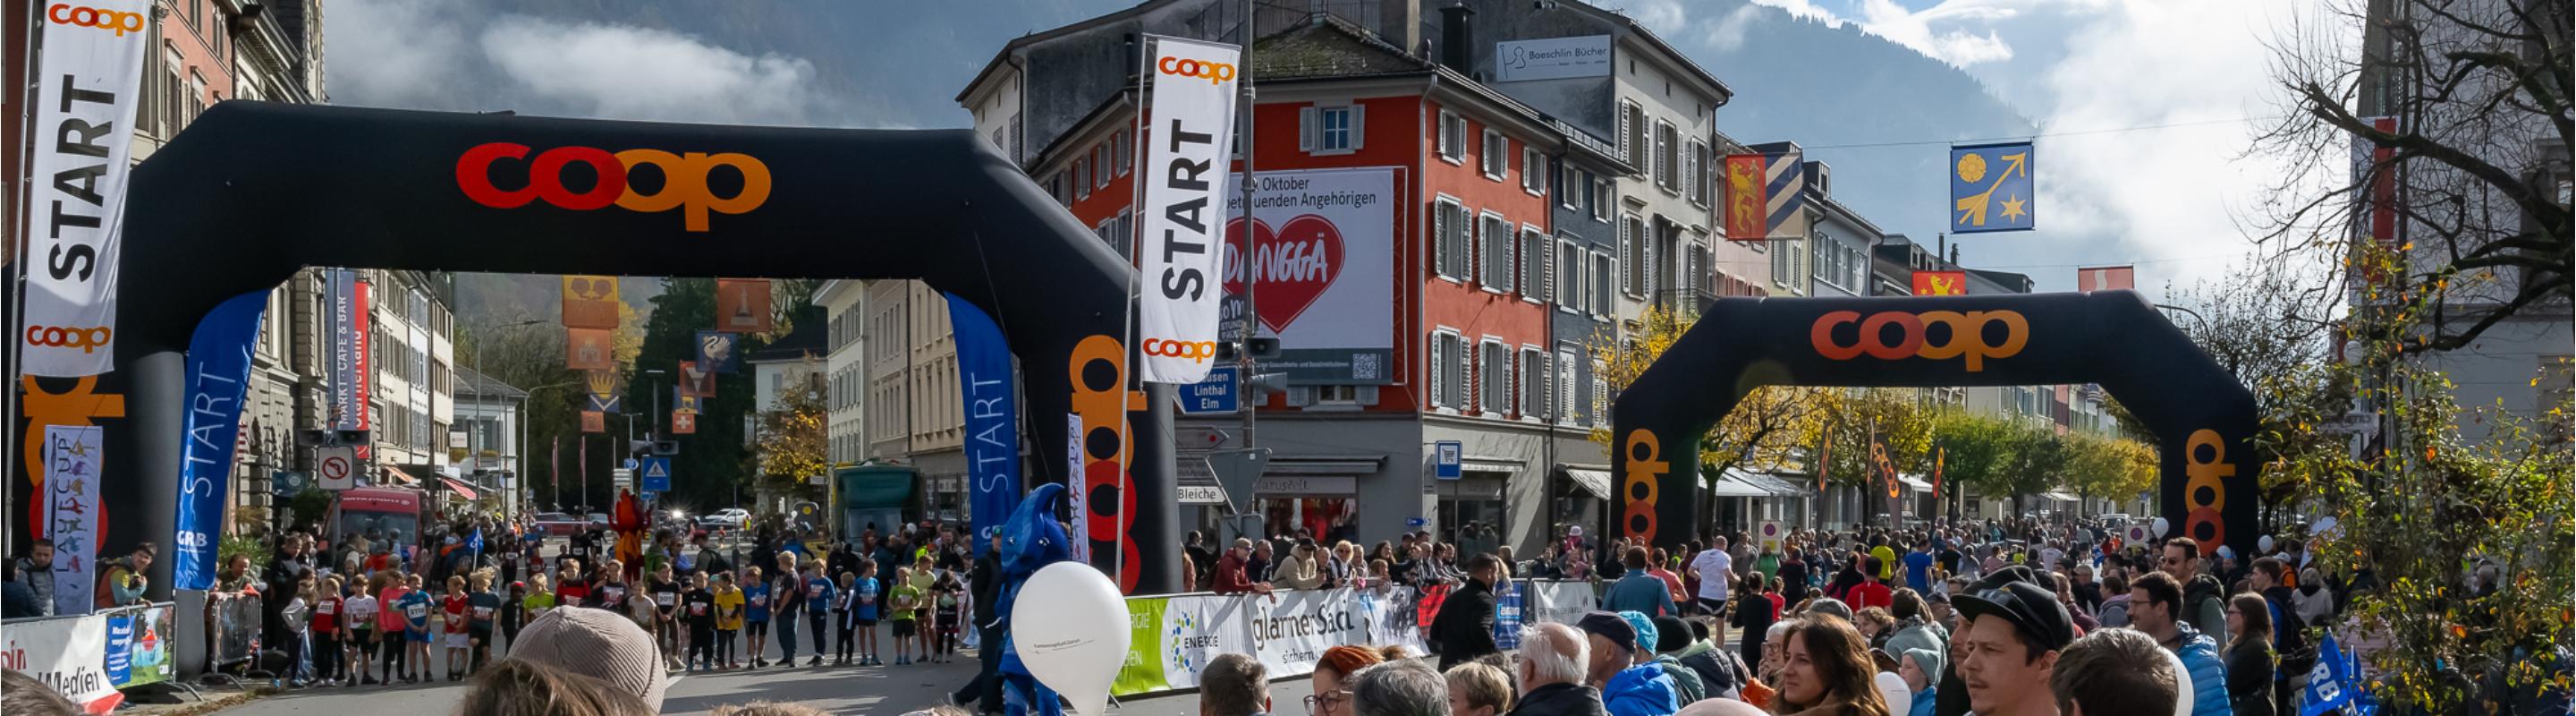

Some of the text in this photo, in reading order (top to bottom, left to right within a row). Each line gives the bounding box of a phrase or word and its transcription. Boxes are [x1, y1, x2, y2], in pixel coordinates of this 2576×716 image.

[49, 4, 144, 37] coop
[1574, 47, 1607, 57] Bücher
[1159, 55, 1235, 85] coop
[48, 74, 115, 283] START
[455, 141, 772, 232] coop
[1262, 177, 1310, 192] Oktober
[1162, 118, 1213, 303] START
[1301, 191, 1377, 209] Angehörigen
[27, 325, 111, 354] coop
[1142, 337, 1216, 364] coop
[1810, 310, 2029, 372] coop
[1194, 385, 1226, 396] Linthal
[1206, 372, 1229, 382] usen
[1201, 397, 1219, 409] Elm
[184, 362, 236, 498] START
[971, 372, 1009, 493] START
[1178, 487, 1216, 500] Bleiche
[1623, 429, 1670, 557] oop
[2185, 429, 2235, 558] oop
[177, 530, 208, 547] GRB
[2311, 661, 2341, 702] RB
